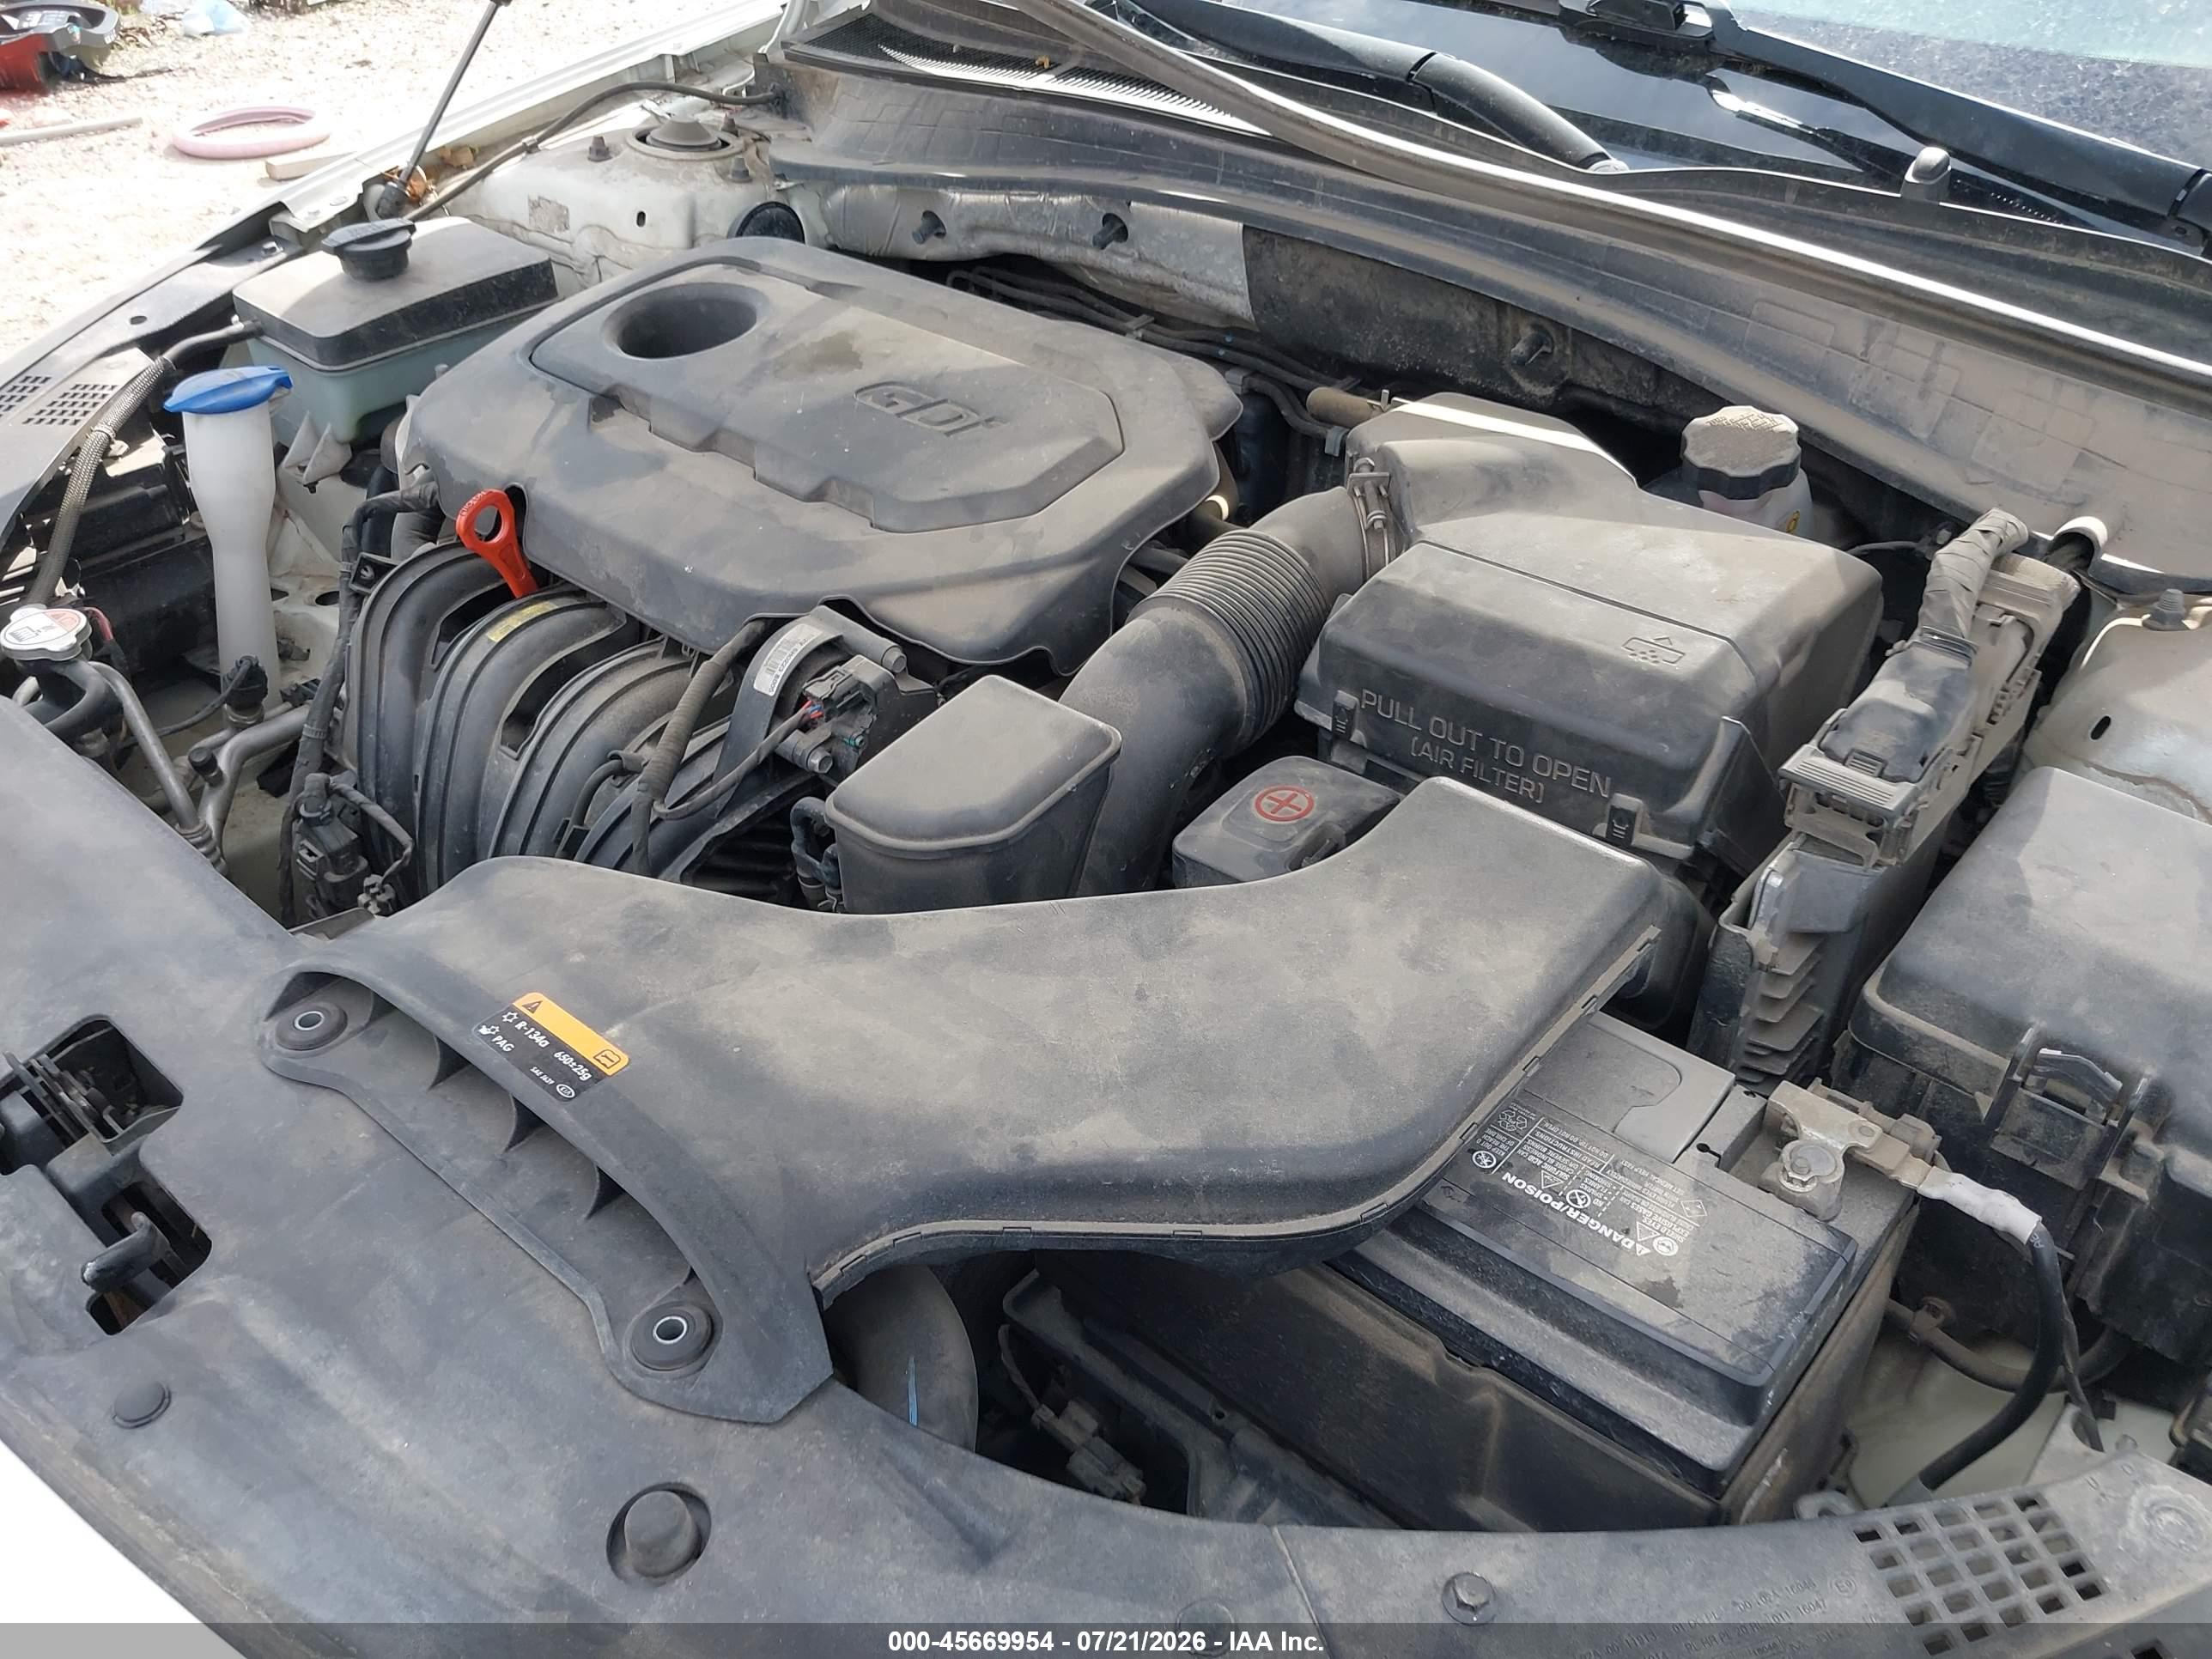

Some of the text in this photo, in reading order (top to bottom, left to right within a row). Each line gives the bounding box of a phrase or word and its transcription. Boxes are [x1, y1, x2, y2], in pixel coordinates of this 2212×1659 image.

[1360, 688, 1611, 798] PULL OUT TO OPEN
[491, 1035, 515, 1052] PAG
[514, 1021, 592, 1082] R-134a 650±25g
[530, 1066, 542, 1077] SAE
[1480, 1139, 1492, 1149] OUT
[1481, 1133, 1510, 1151] THE REACH
[1491, 1146, 1505, 1156] KEEP
[1522, 1144, 1574, 1175] CAUSE BLINDNESS
[1545, 1149, 1569, 1164] SEVERE
[1516, 1148, 1570, 1180] SULFURIC ACID CAN
[1568, 1161, 1578, 1170] OR
[1581, 1155, 1600, 1168] READ
[1583, 1170, 1612, 1188] SMOKING
[1583, 1177, 1607, 1193] FLAMES
[1578, 1182, 1603, 1199] SPARKS
[1501, 1171, 1637, 1249] DANGER/POISON
[1591, 1197, 1604, 1206] NO
[1629, 1201, 1652, 1217] GASES
[1651, 1212, 1690, 1237] EXPLOSIVE
[1660, 1226, 1686, 1243] SHIELD
